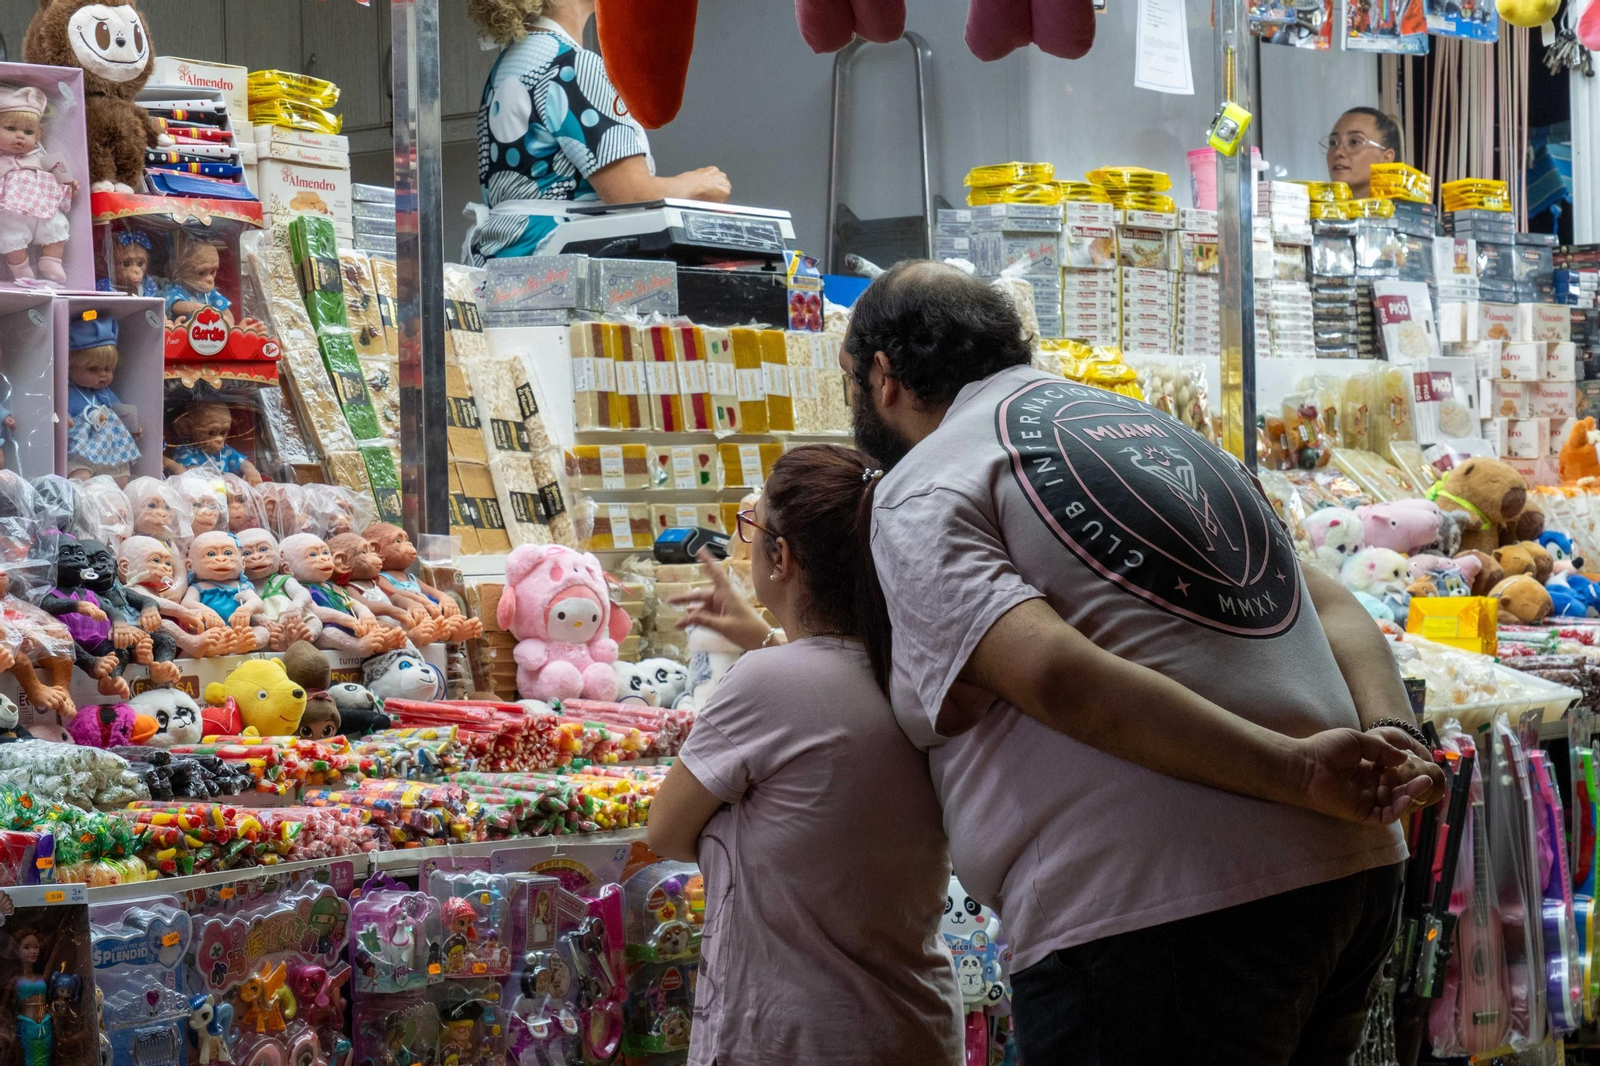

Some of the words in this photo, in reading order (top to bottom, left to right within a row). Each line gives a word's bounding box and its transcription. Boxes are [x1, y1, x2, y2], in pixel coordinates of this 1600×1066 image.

[187, 74, 234, 91] Almendro
[289, 176, 336, 191] Almendro
[1072, 227, 1082, 236] Dos
[1183, 234, 1193, 242] Dos
[1194, 235, 1218, 243] Hermano
[192, 326, 226, 342] Gordis
[1020, 386, 1152, 487] INTERNACIONAL
[1082, 422, 1170, 442] MIAMI
[1065, 501, 1144, 569] CLUB
[1217, 590, 1278, 618] MMXX
[340, 657, 363, 665] turro
[335, 867, 348, 880] 3+
[72, 888, 81, 896] 3+
[93, 947, 149, 965] SPLENDID
